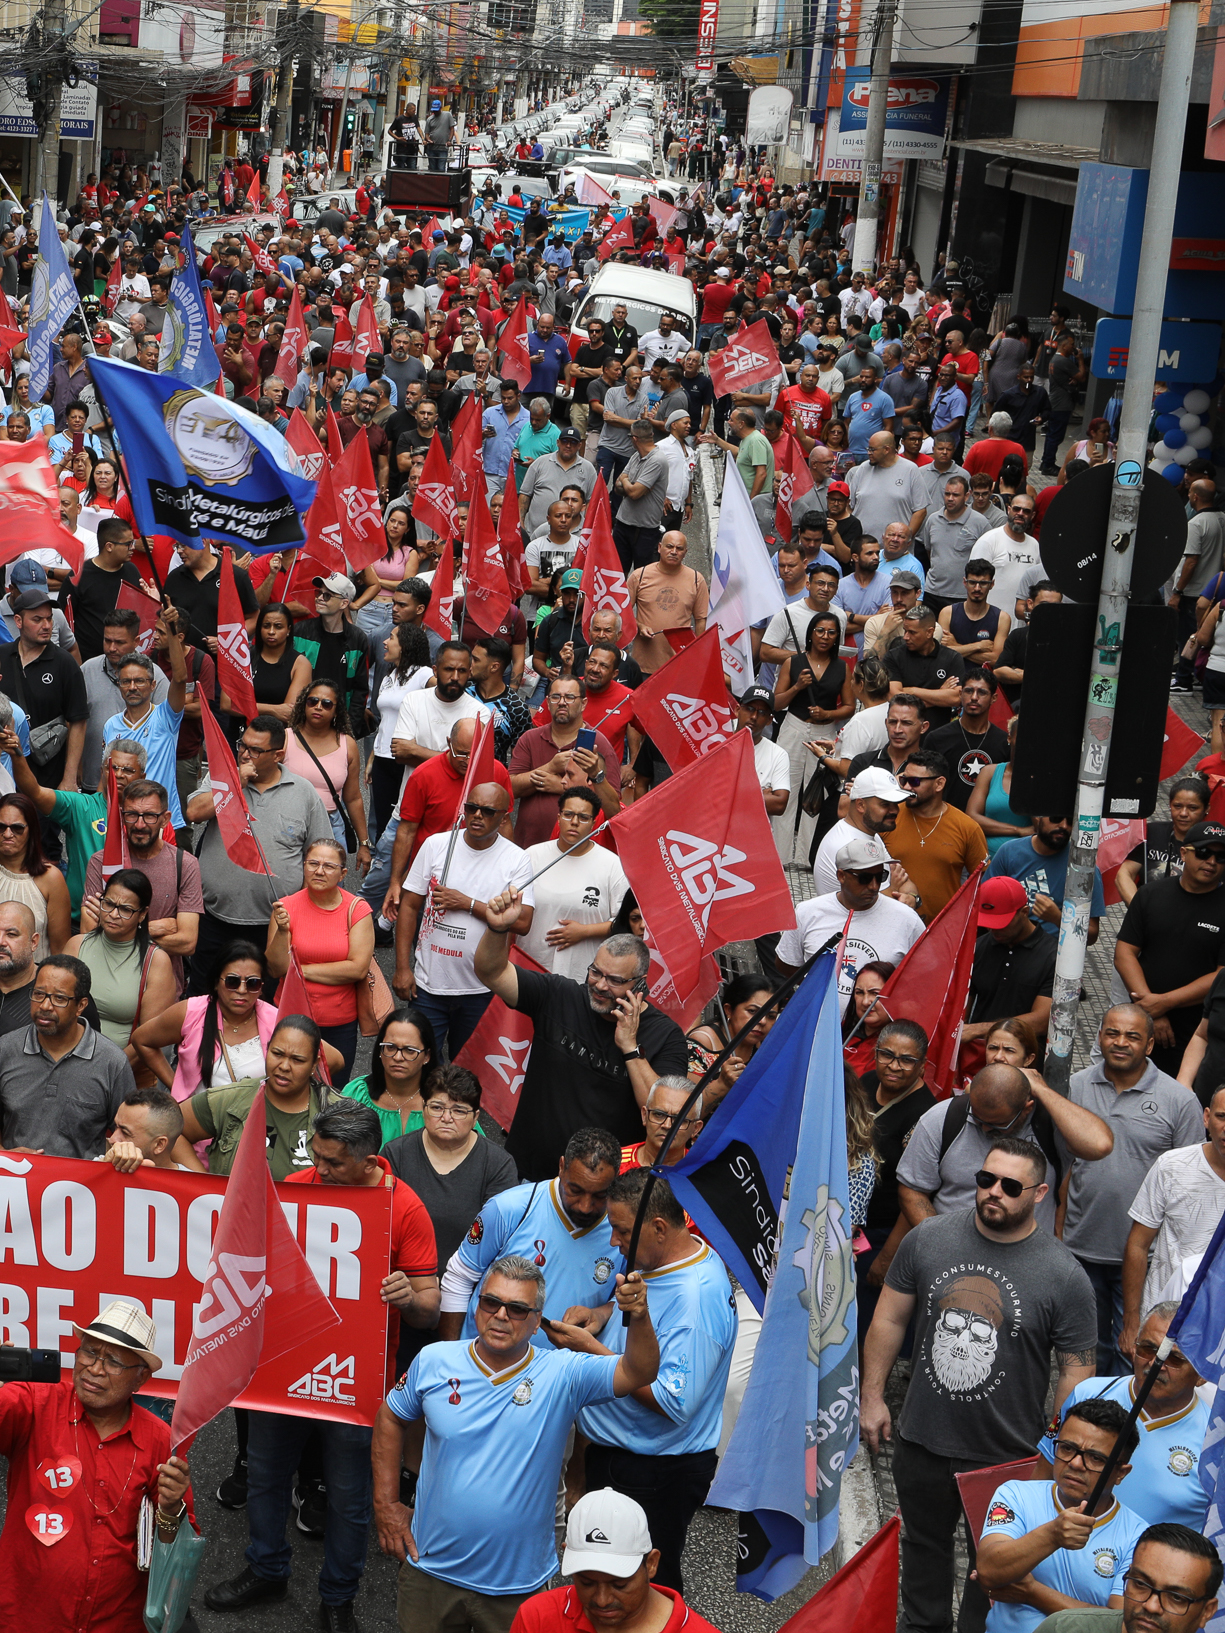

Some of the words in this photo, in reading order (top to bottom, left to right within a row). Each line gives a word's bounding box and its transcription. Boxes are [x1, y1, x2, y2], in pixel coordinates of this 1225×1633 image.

[854, 82, 936, 103] Pena
[899, 112, 932, 121] FUNERAL
[1077, 553, 1098, 570] 08/14
[657, 835, 674, 873] SINDICATO
[438, 946, 463, 959] MEDULA
[123, 1186, 227, 1285] DO
[287, 1373, 357, 1401] ABC
[287, 1392, 311, 1401] SINDICATO
[44, 1466, 74, 1489] 13
[34, 1513, 64, 1535] 13
